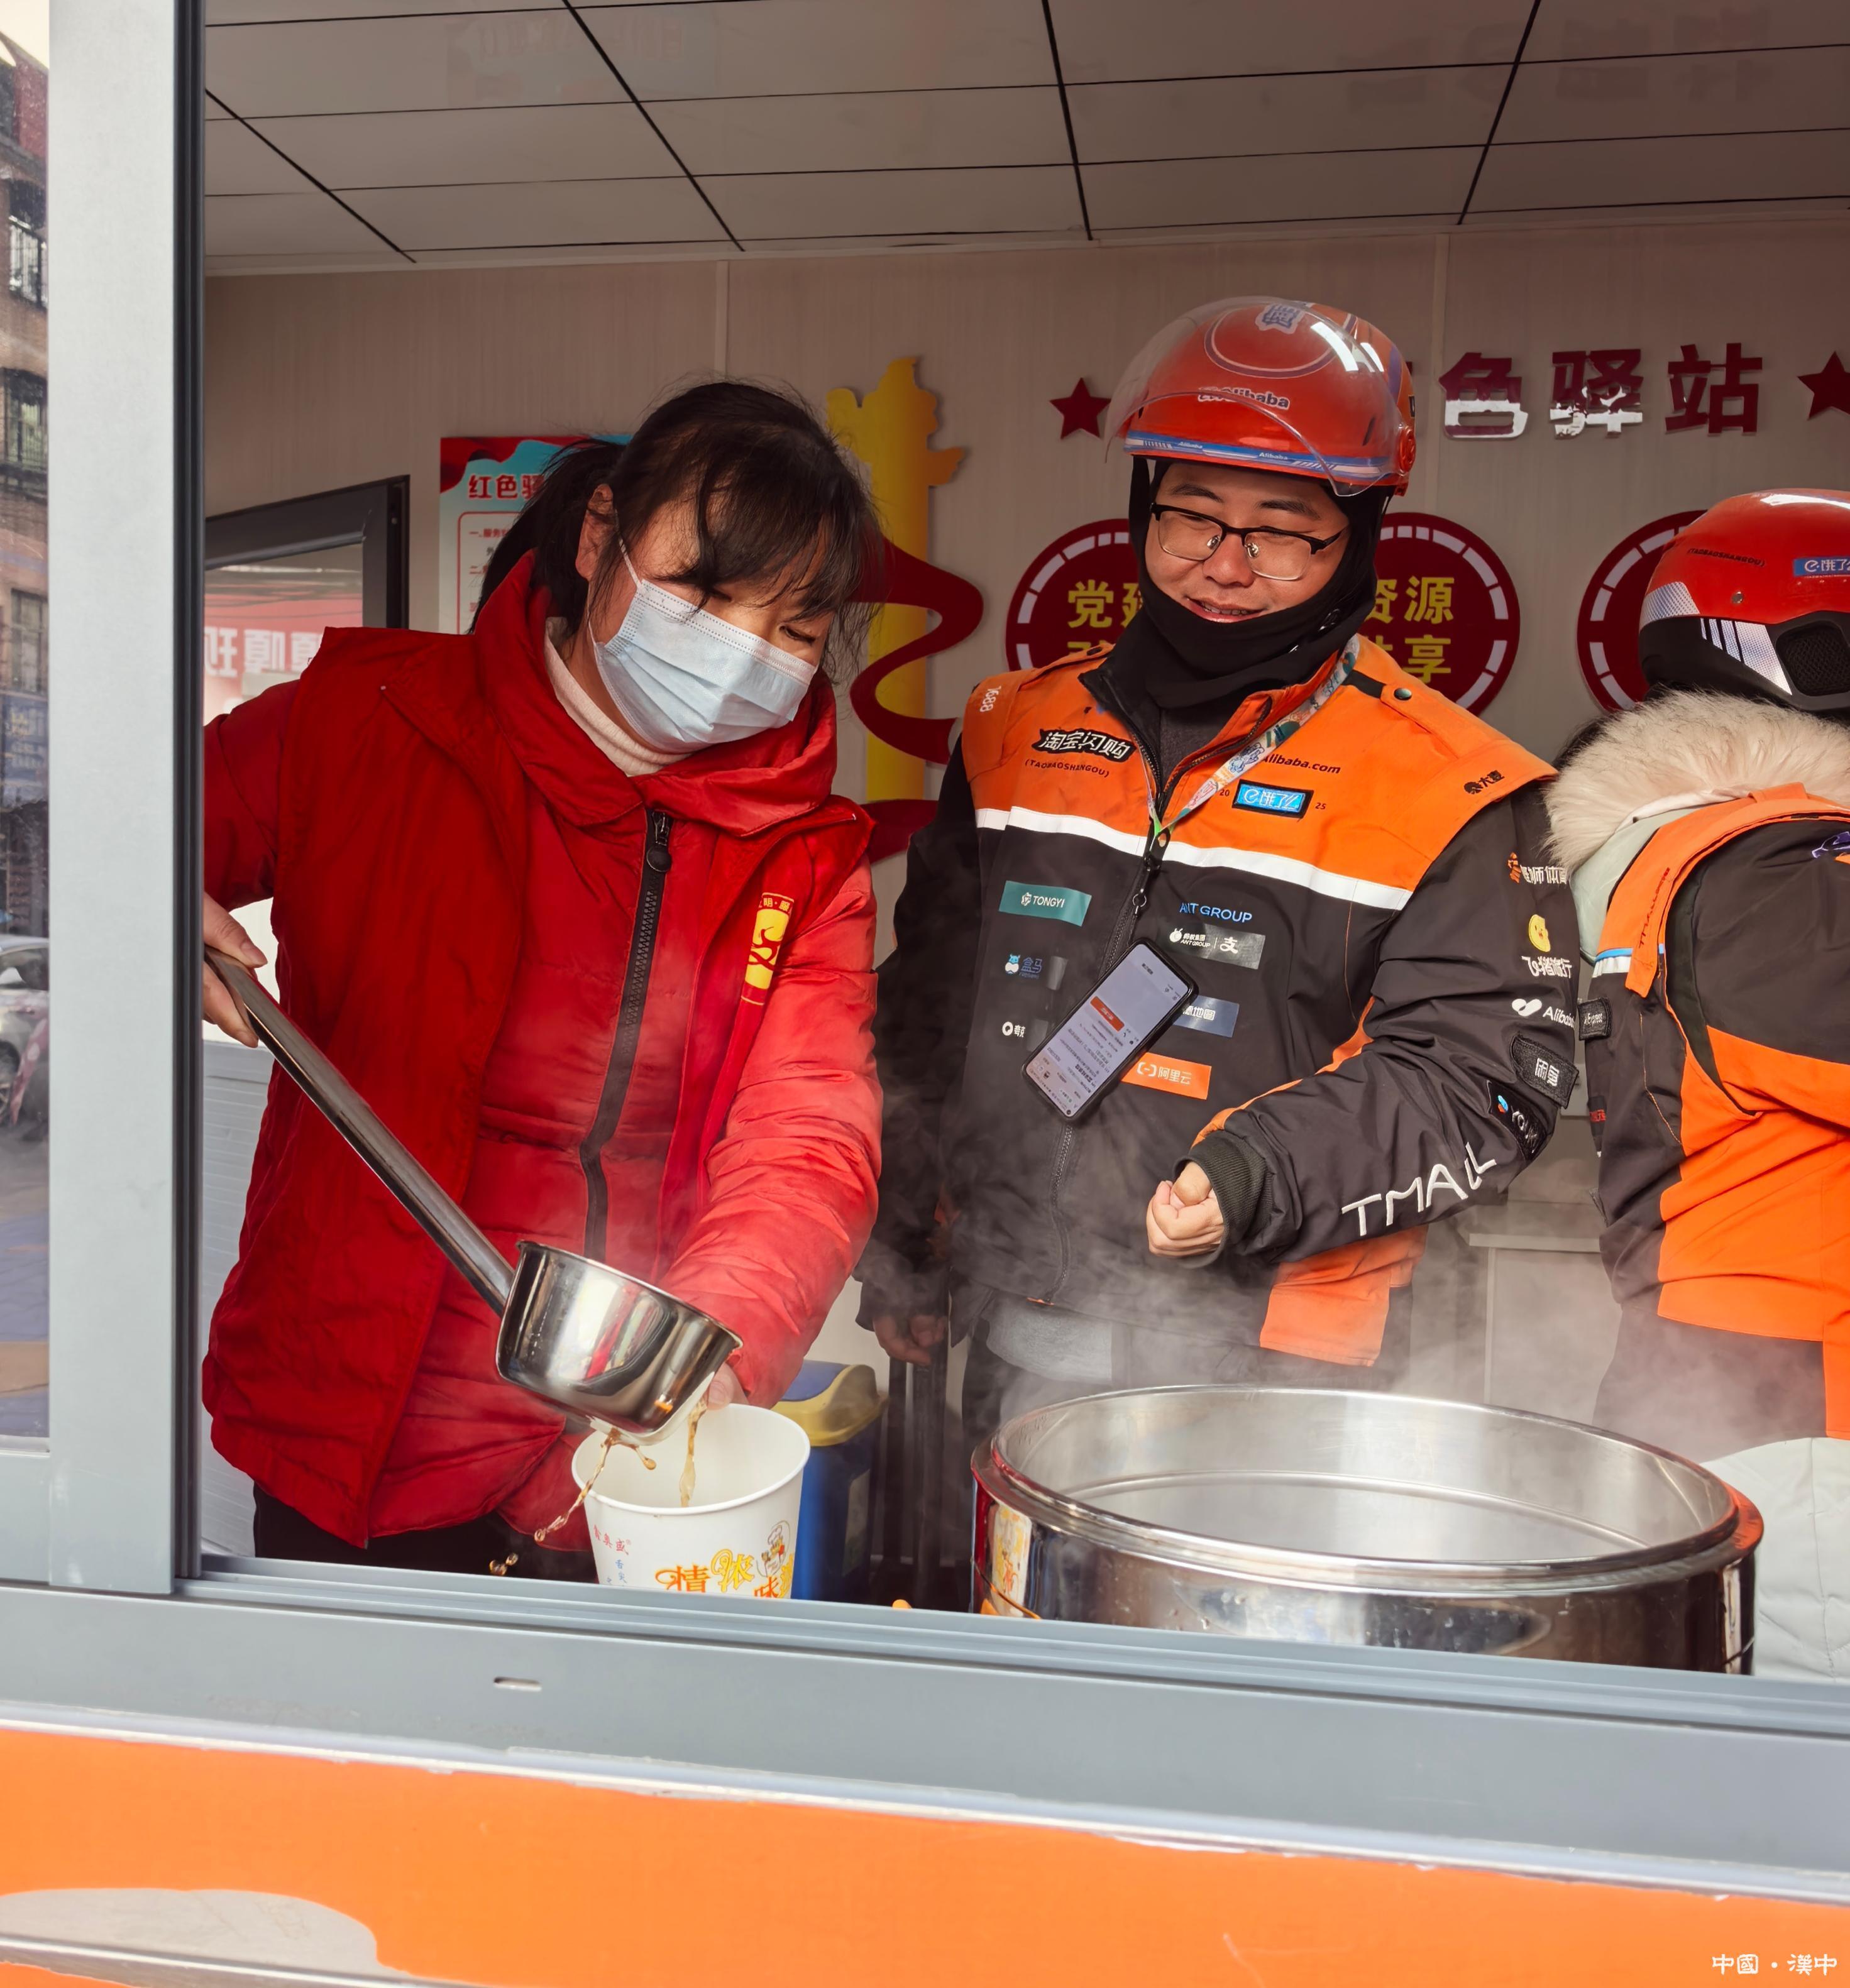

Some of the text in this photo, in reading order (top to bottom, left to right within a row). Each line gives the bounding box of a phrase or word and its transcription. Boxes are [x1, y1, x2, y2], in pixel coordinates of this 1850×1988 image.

[1406, 343, 1763, 440] 色驿站
[1259, 451, 1289, 460] Alibaba
[1367, 634, 1451, 684] 享
[979, 685, 1002, 713] 1688
[1038, 730, 1131, 759] 淘宝闪购
[1220, 789, 1230, 798] 20
[1315, 802, 1327, 811] 25
[1032, 895, 1066, 909] TONGYI
[1199, 905, 1253, 923] GROUP
[1021, 957, 1043, 974] 盒马
[1158, 1067, 1192, 1085] 阿里云
[1341, 1141, 1497, 1237] TMALL
